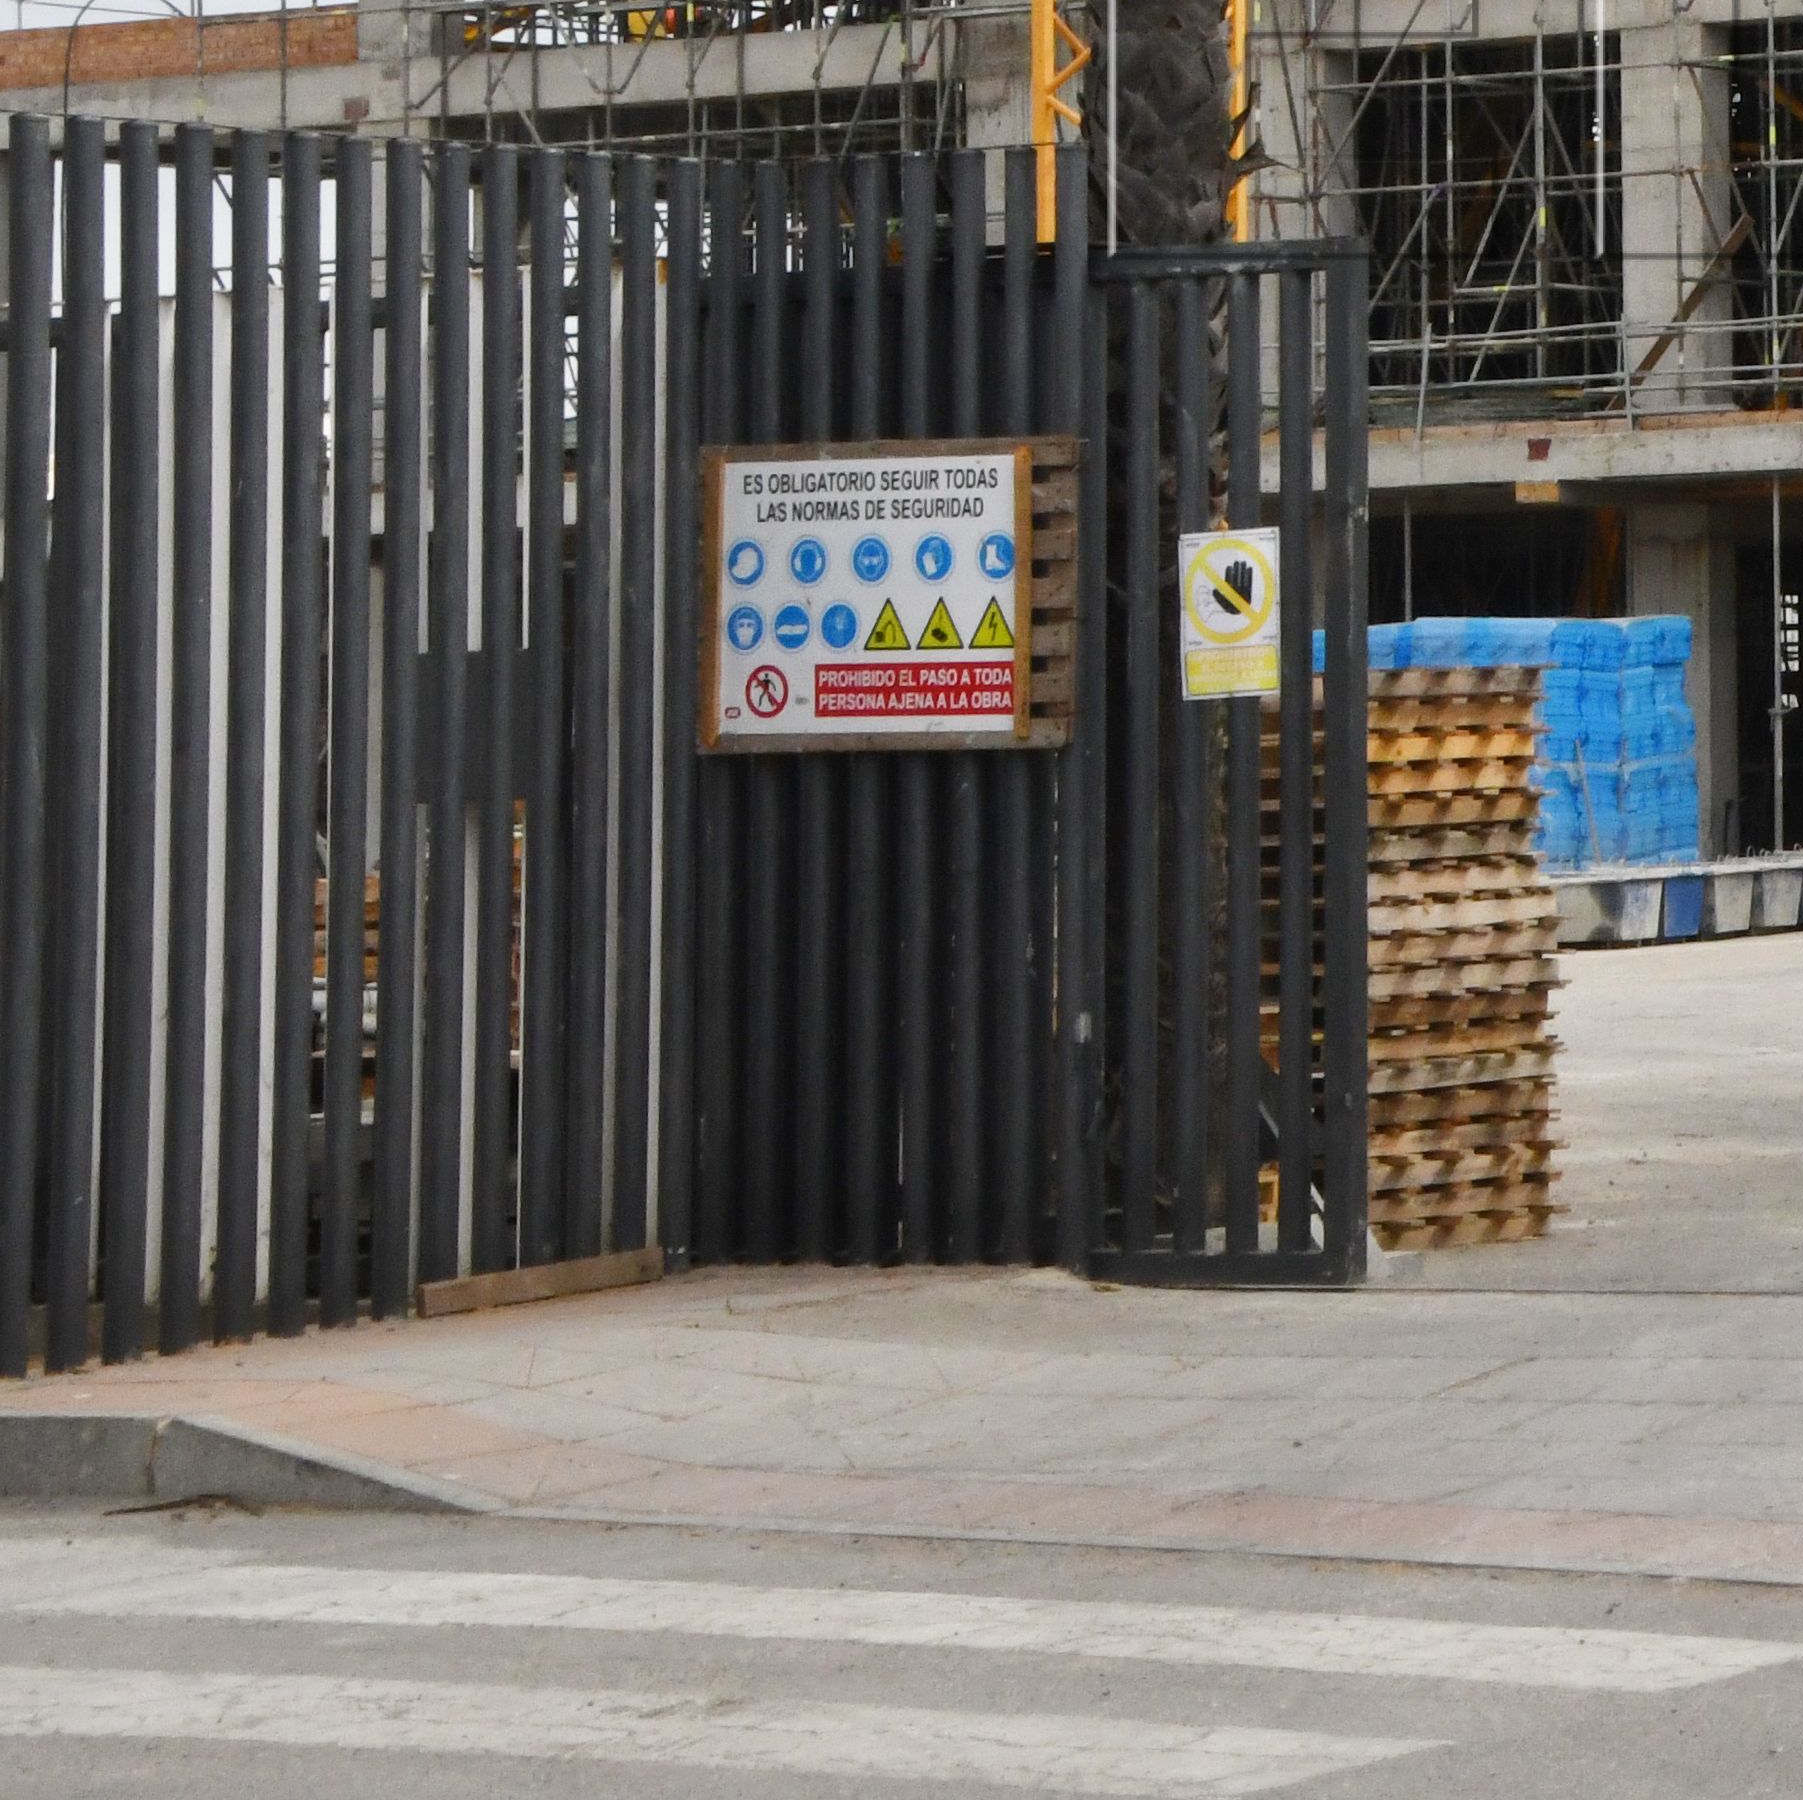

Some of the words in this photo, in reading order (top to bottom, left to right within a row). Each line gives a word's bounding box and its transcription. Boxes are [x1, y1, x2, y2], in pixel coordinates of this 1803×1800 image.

[743, 474, 763, 495] ES
[768, 471, 875, 494] OBLIGATORIO
[880, 469, 940, 491] SEGUIR
[944, 468, 998, 489] TODAS
[757, 502, 787, 523] LAS
[792, 499, 860, 522] NORMAS
[865, 499, 885, 520] DE
[891, 497, 984, 520] SEGURIDAD
[818, 669, 895, 688] PROHIBIDO
[901, 669, 916, 686] EL
[919, 668, 958, 686] PASO
[960, 668, 972, 685] A
[973, 667, 1012, 685] TODA
[818, 693, 886, 711] PERSONA
[888, 692, 936, 710] AJENA
[937, 691, 948, 709] A
[950, 691, 967, 709] LA
[971, 690, 1012, 708] OBRA
